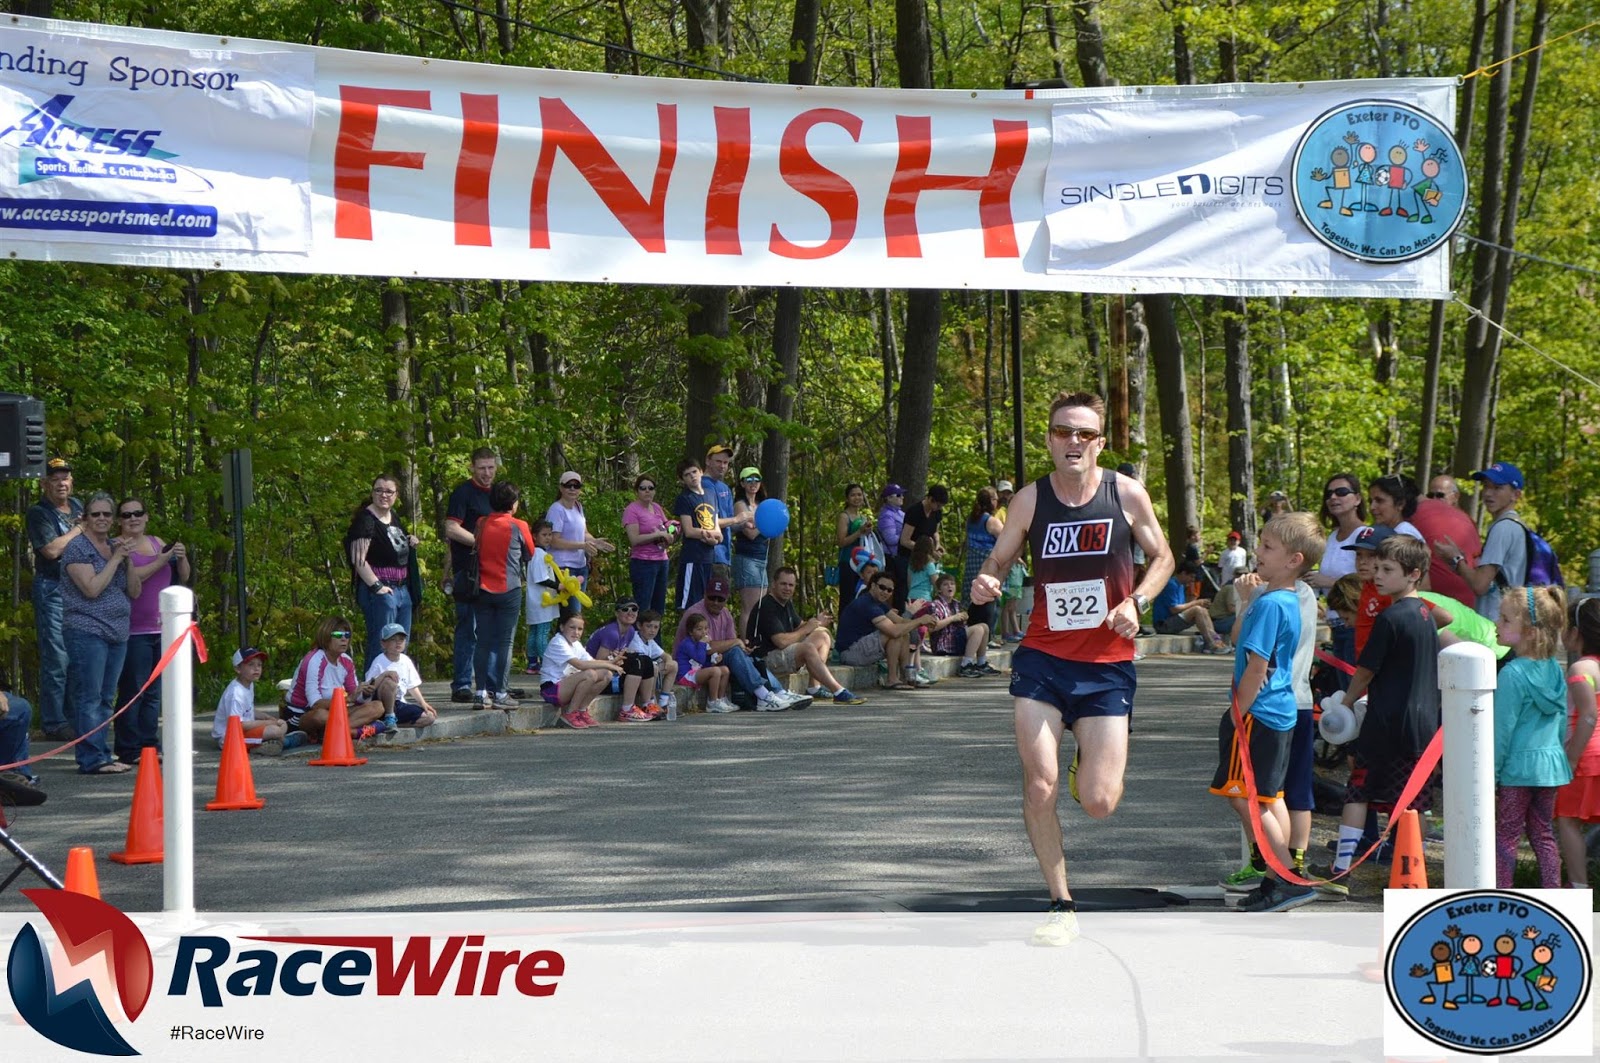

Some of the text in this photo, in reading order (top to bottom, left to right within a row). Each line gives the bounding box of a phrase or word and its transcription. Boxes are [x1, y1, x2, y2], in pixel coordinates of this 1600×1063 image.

[0, 46, 239, 91] nding Sponsor
[1346, 110, 1420, 130] Exeter PTO
[37, 160, 67, 174] Sports
[334, 84, 1029, 260] FINISH
[1321, 222, 1437, 256] Together We Can Do More
[1048, 523, 1107, 554] SIX03
[1055, 595, 1099, 617] 322
